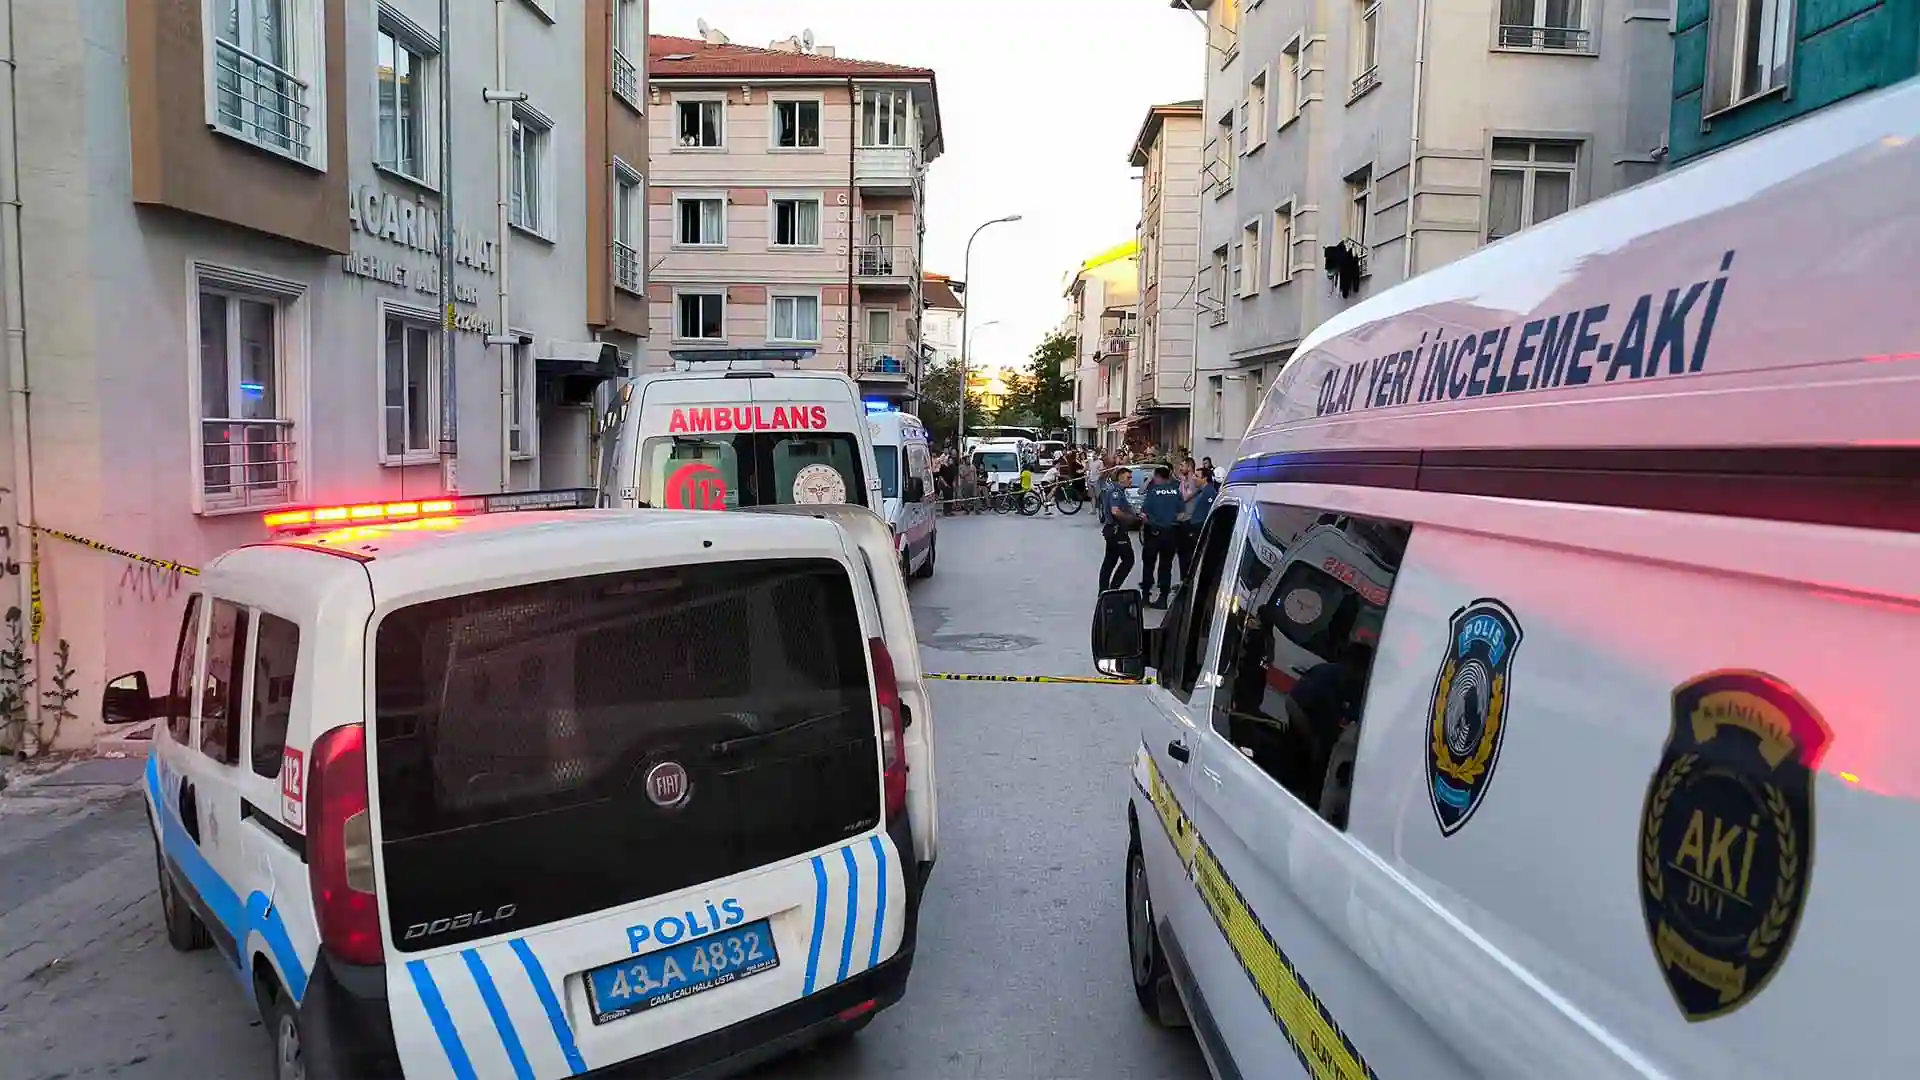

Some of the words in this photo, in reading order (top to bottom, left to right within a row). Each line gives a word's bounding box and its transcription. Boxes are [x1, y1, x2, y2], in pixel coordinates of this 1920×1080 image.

[342, 251, 409, 288] MEHMET
[1317, 361, 1369, 417] OLAY
[1364, 332, 1428, 410] YERİ
[1417, 249, 1736, 403] İNCELEME-AKİ
[669, 405, 828, 433] AMBULANS
[688, 478, 728, 511] 112
[284, 755, 300, 796] 112
[655, 773, 681, 797] FIAT
[1676, 809, 1760, 898] AKİ
[404, 903, 519, 940] DOBLO
[626, 898, 745, 954] POLİS
[611, 964, 649, 999] 43
[661, 955, 687, 988] A
[692, 932, 764, 977] 4832
[714, 972, 735, 986] USTA
